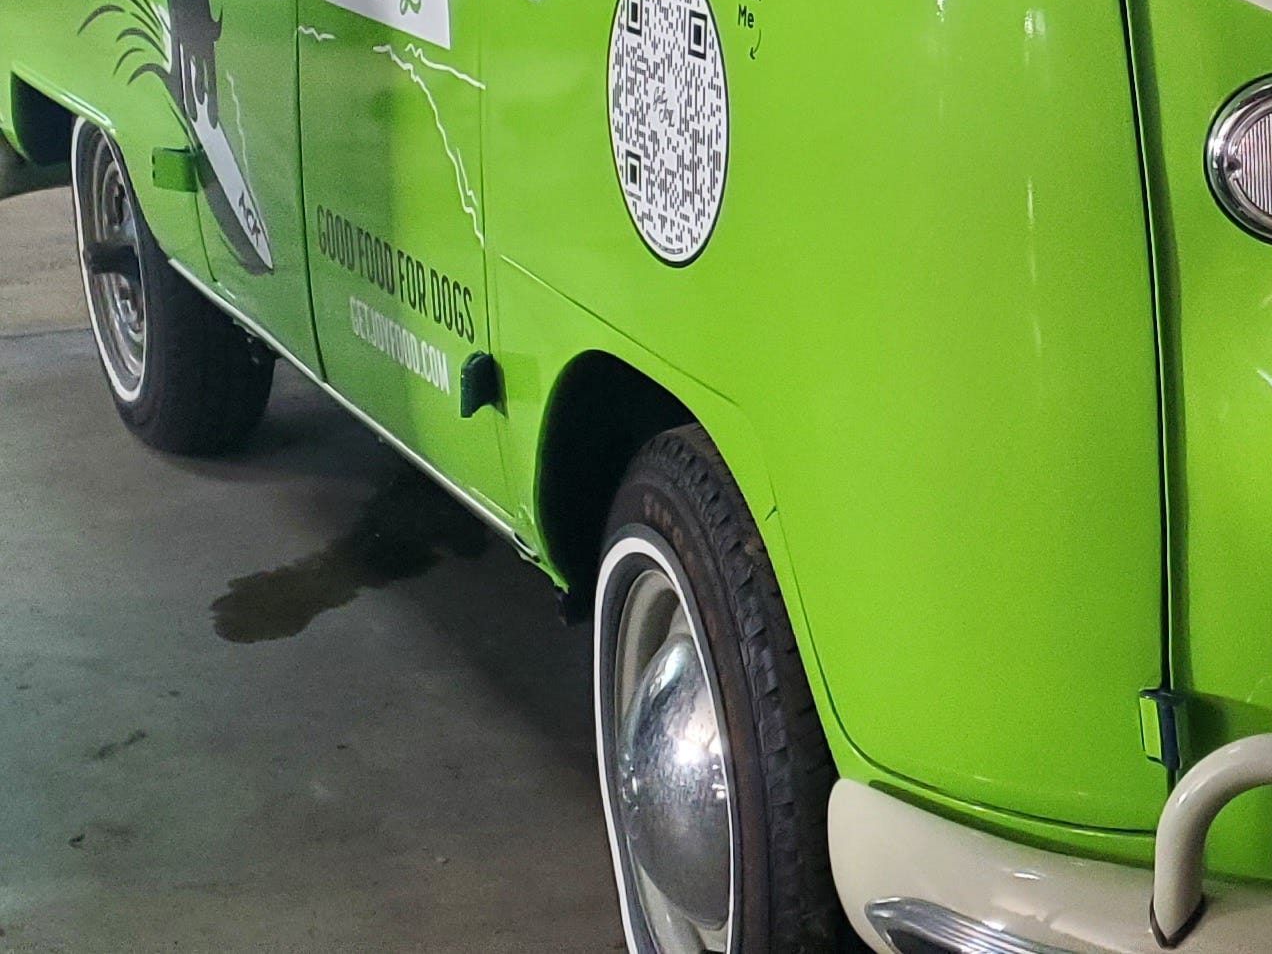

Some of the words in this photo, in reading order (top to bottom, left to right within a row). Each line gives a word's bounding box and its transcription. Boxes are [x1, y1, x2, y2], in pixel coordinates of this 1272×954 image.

[737, 3, 755, 29] Me
[317, 204, 355, 271] GOOD
[356, 226, 395, 296] FOOD
[397, 249, 428, 316] FOR
[430, 267, 475, 344] DOGS
